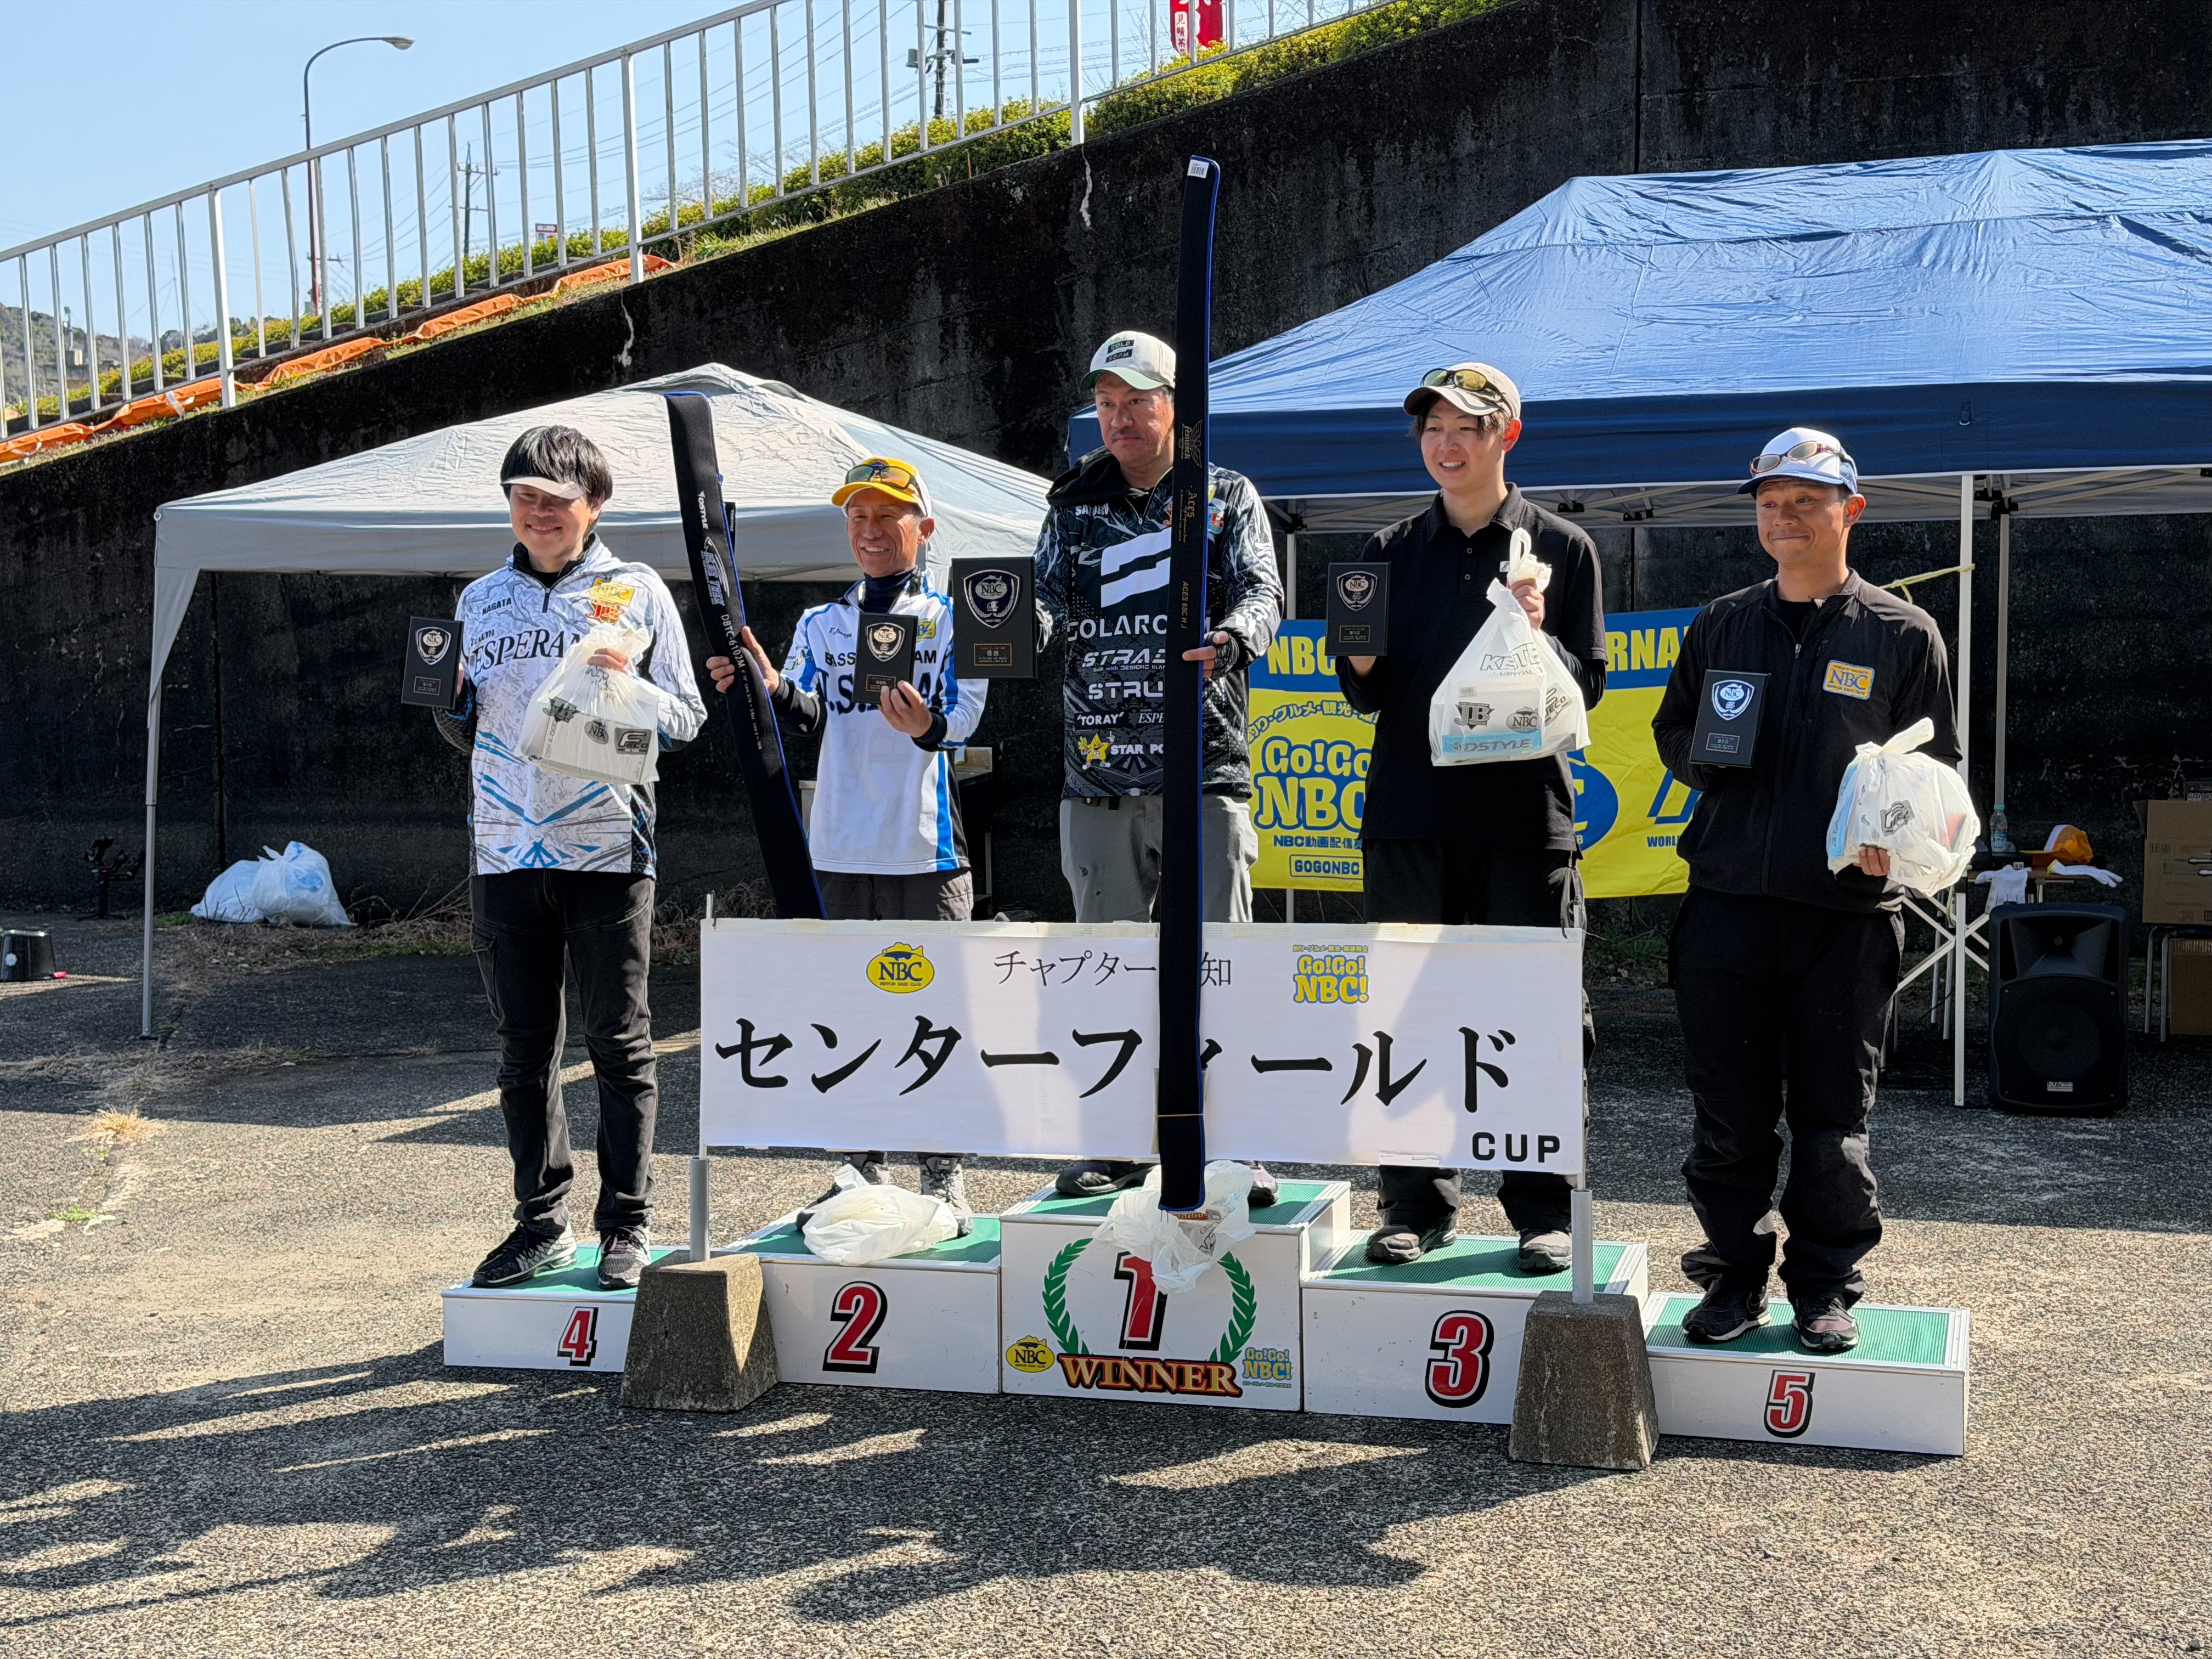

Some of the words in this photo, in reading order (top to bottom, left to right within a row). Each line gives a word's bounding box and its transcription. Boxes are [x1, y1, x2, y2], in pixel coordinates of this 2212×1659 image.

[1110, 341, 1131, 351] SOLA
[1183, 424, 1192, 460] fenwick
[698, 497, 709, 530] DSTYLE
[1186, 490, 1198, 518] Aces
[594, 584, 630, 601] NBC
[981, 584, 1002, 594] NBC
[482, 597, 511, 615] NAGATA
[721, 614, 746, 668] DBTC-6102M
[1605, 625, 1691, 672] RNA
[825, 652, 856, 667] BASS
[915, 650, 936, 664] AM
[1828, 668, 1869, 691] NBC
[1454, 706, 1491, 725] JB
[1513, 716, 1537, 727] NBC
[1110, 744, 1144, 755] STAR
[1464, 738, 1532, 752] DSTYLE
[1264, 739, 1371, 778] Go!Go
[1294, 859, 1360, 875] GOGONBC
[878, 961, 923, 981] NBC
[994, 950, 1231, 987] チャプター知
[1298, 955, 1365, 975] Go!Go!
[1294, 974, 1368, 1003] NBC!
[1472, 1132, 1560, 1163] CUP
[1114, 1251, 1169, 1351] 1
[557, 1306, 599, 1367] 4
[823, 1281, 888, 1374] 2
[1014, 1349, 1047, 1364] NBC
[1426, 1310, 1494, 1408] 3
[1058, 1354, 1243, 1397] WINNER
[1243, 1360, 1291, 1379] NBC!
[1764, 1369, 1815, 1438] 5
